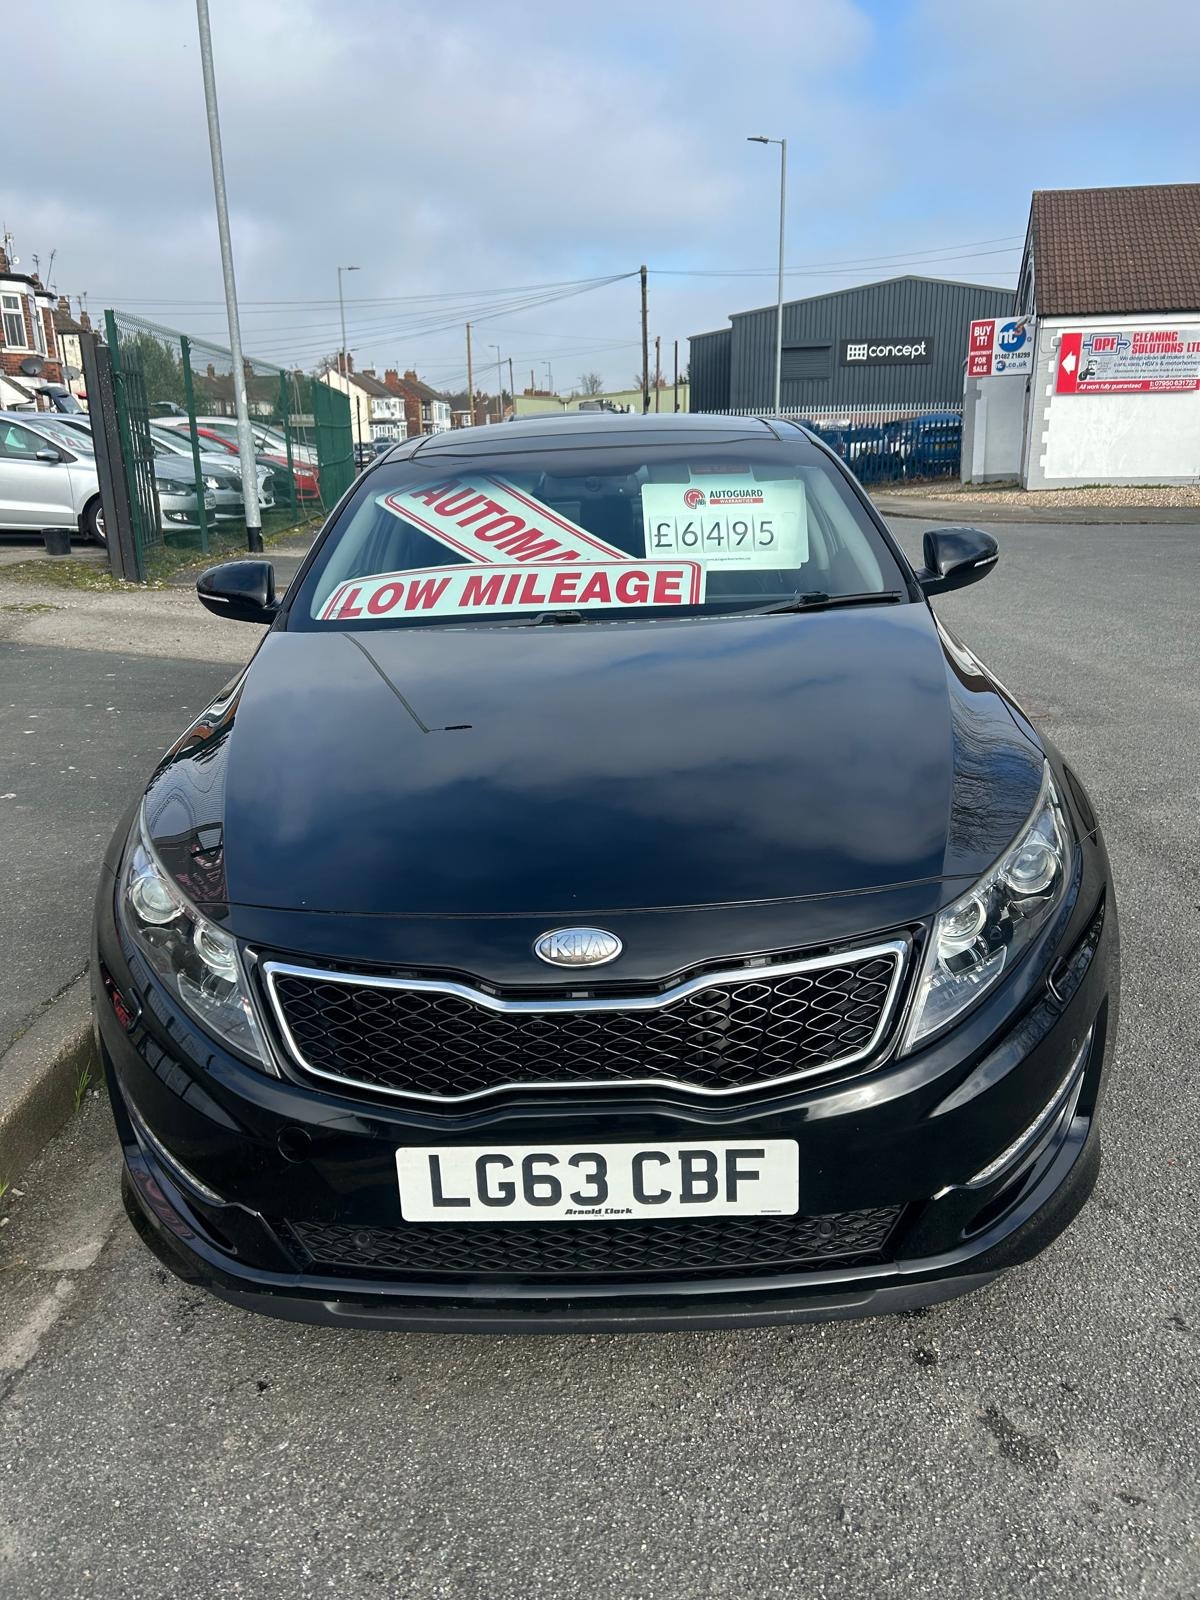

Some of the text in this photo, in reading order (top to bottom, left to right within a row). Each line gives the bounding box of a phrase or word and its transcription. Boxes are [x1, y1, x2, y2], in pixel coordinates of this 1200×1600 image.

[974, 326, 992, 336] BUY
[1133, 331, 1178, 343] CLEANING
[977, 336, 988, 346] IT!
[1093, 337, 1117, 351] DPF
[868, 341, 926, 359] concept
[1132, 342, 1184, 354] SOLUTIONS
[974, 356, 987, 365] FOR
[973, 365, 988, 373] SALE
[1112, 382, 1142, 390] guaranteed
[50, 431, 93, 449] SAL
[709, 489, 763, 498] AUTOGUARD
[654, 521, 774, 547] £6495
[337, 570, 683, 619] LOW MILEAGE
[550, 935, 609, 957] KIA
[428, 1148, 765, 1207] LG63 CBF
[605, 1207, 633, 1215] Clark
